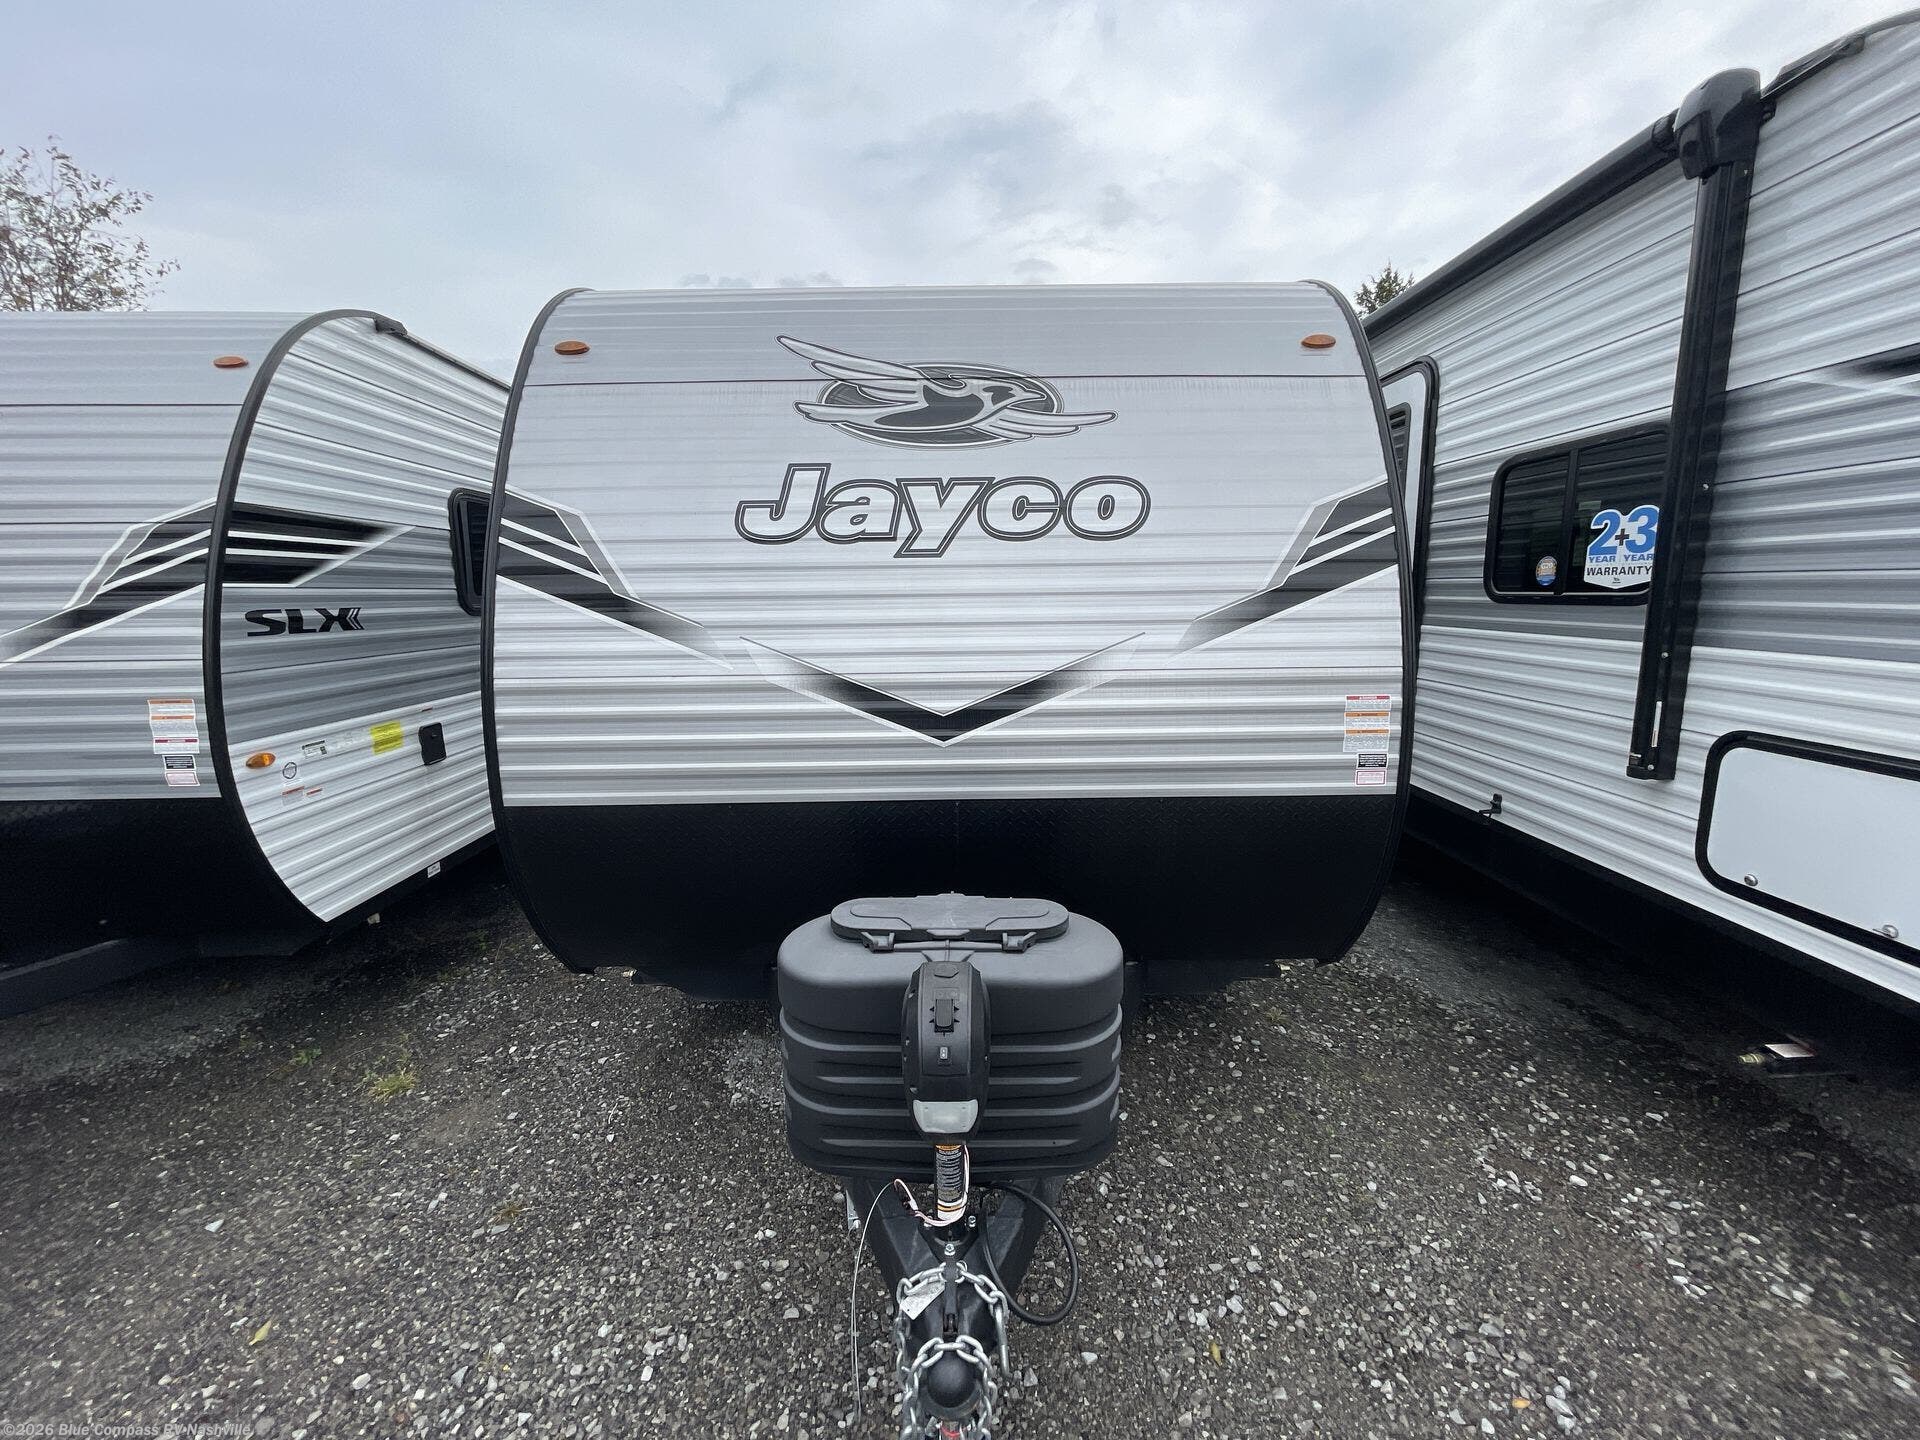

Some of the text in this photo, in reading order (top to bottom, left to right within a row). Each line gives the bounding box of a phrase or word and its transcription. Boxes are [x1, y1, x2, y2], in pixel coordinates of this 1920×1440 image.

[735, 463, 1151, 558] Jayco
[1588, 553, 1654, 563] YEAR YEAR
[1586, 565, 1653, 576] WARRANTY
[244, 607, 365, 637] SLX
